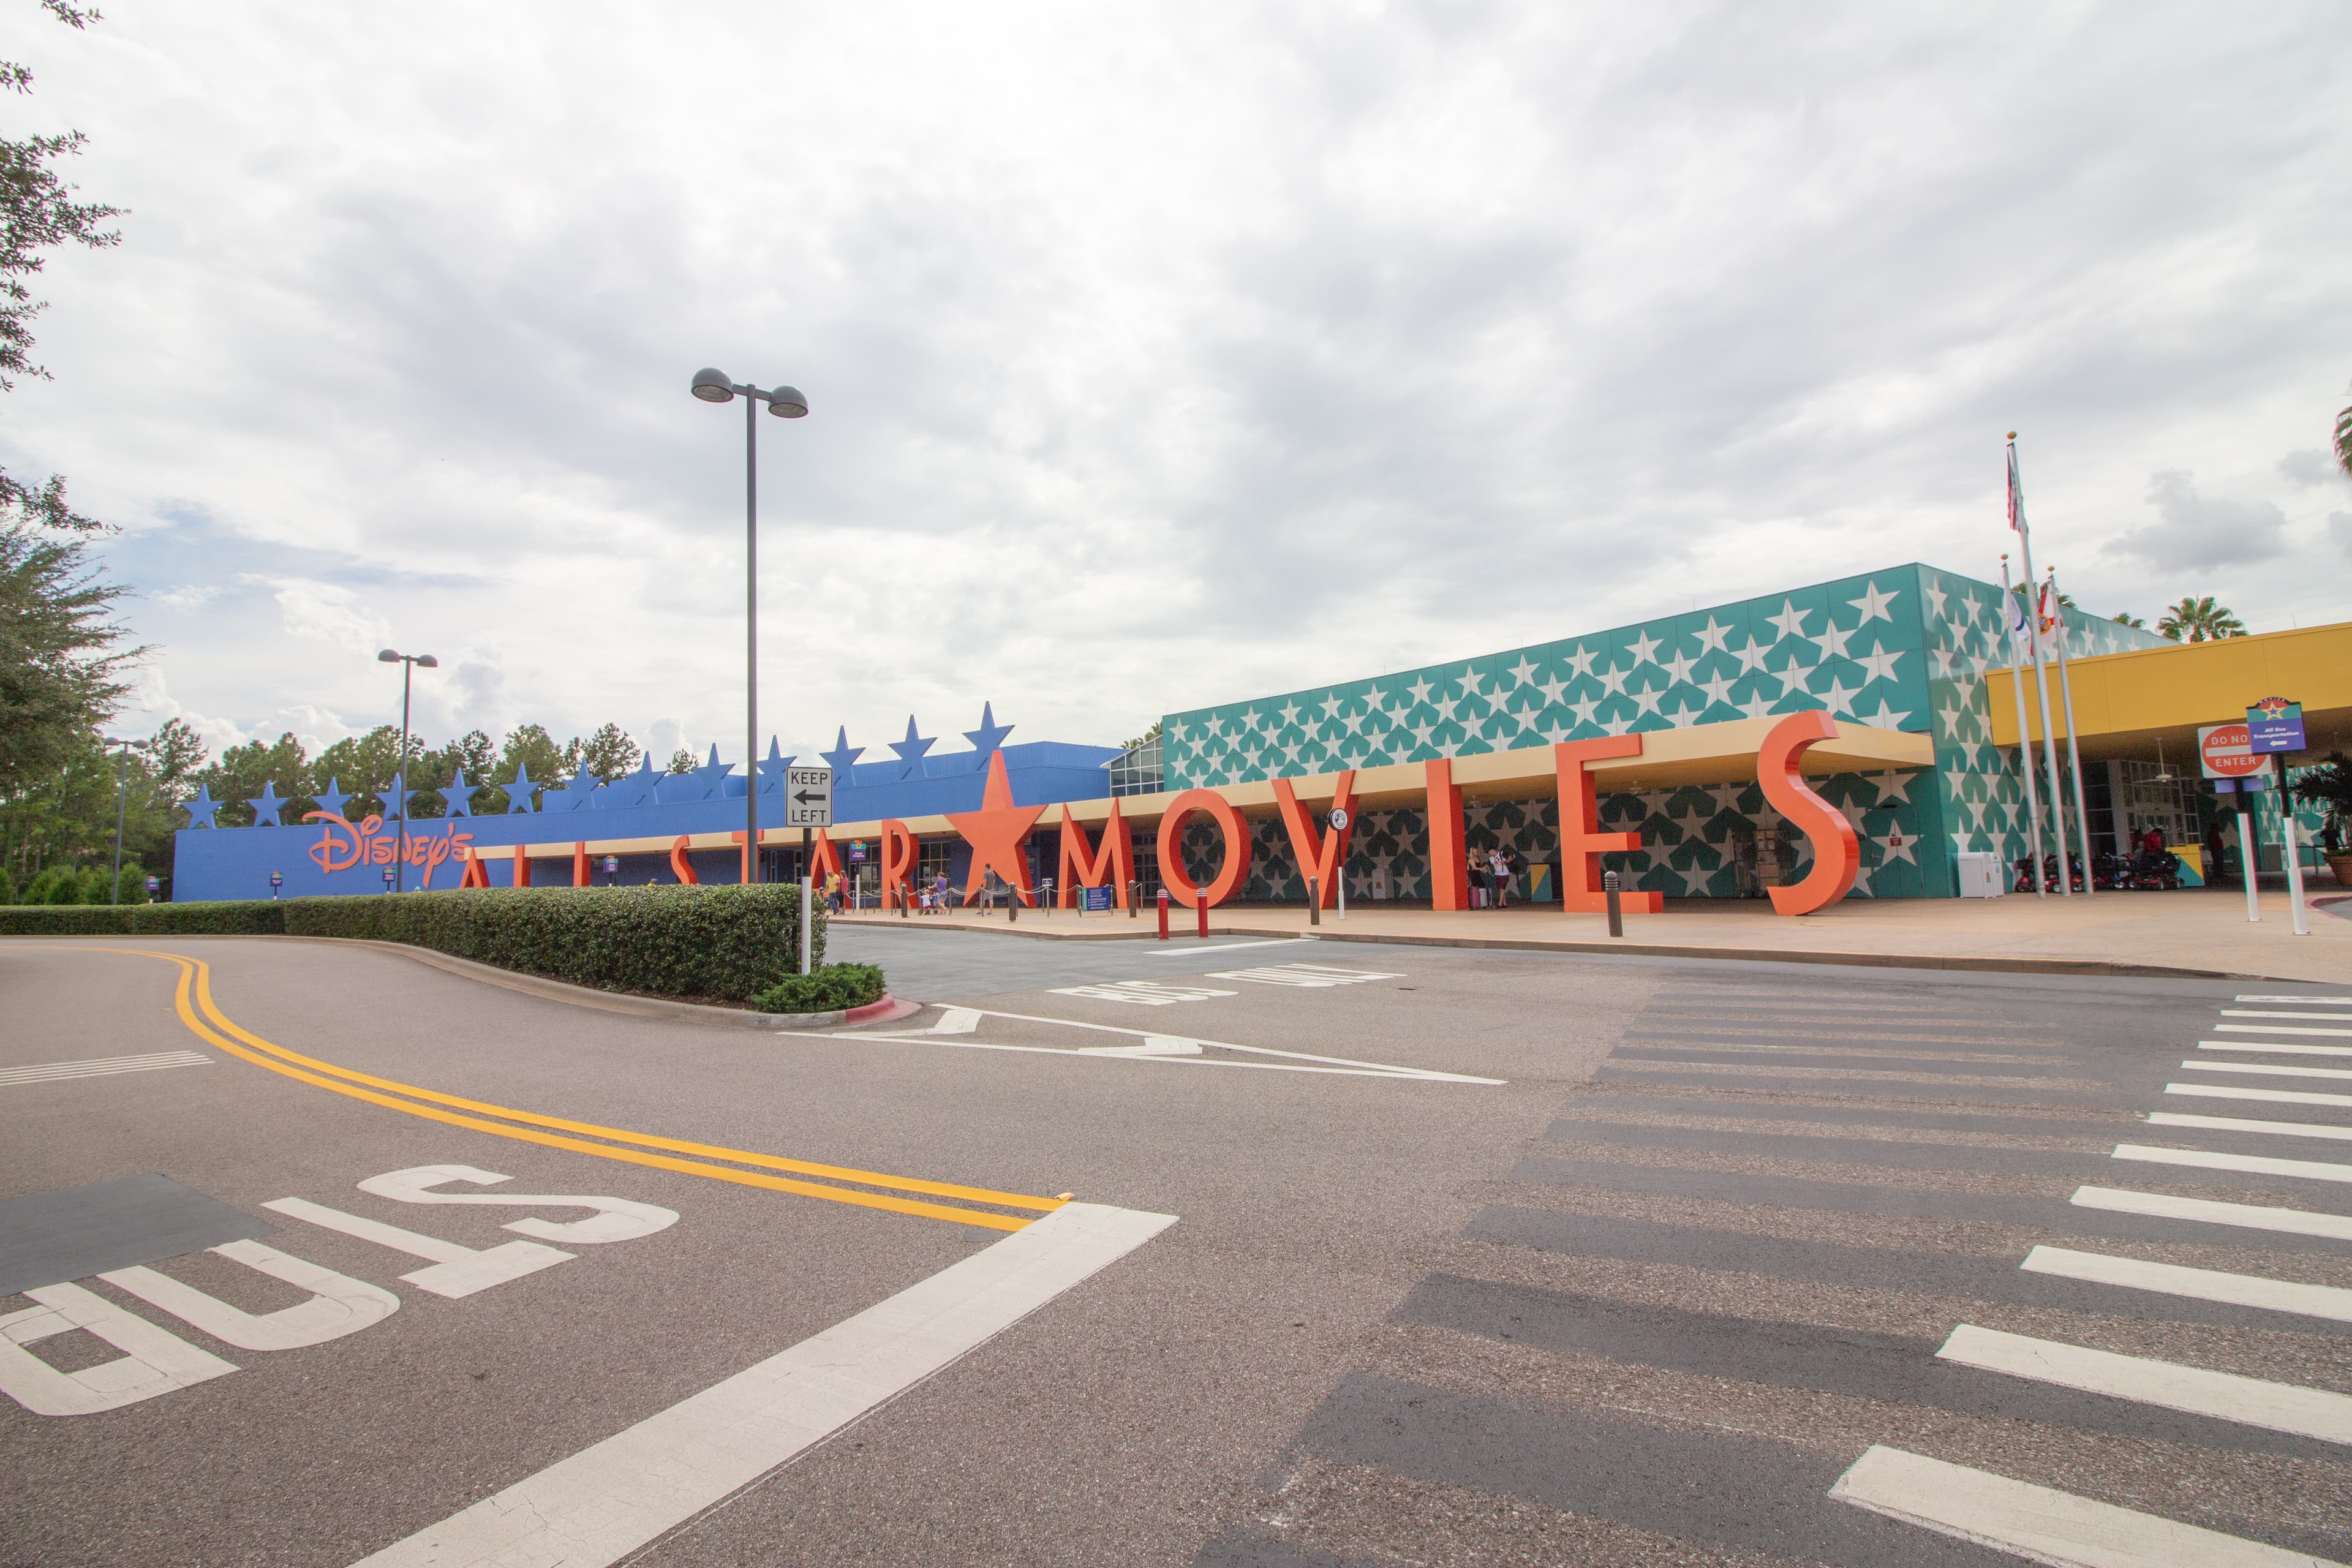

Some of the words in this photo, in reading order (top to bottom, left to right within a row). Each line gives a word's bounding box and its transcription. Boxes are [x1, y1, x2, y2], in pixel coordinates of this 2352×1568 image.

[2231, 734, 2248, 743] NO
[2215, 756, 2256, 767] ENTER
[791, 772, 827, 785] KEEP
[671, 819, 920, 909] STAR
[1057, 709, 1860, 915] MOVIES
[792, 810, 826, 822] LEFT
[301, 810, 474, 888] Disney's
[1204, 963, 1408, 987] ONLY
[1045, 981, 1240, 1006] BUS
[0, 1165, 680, 1416] STOP
